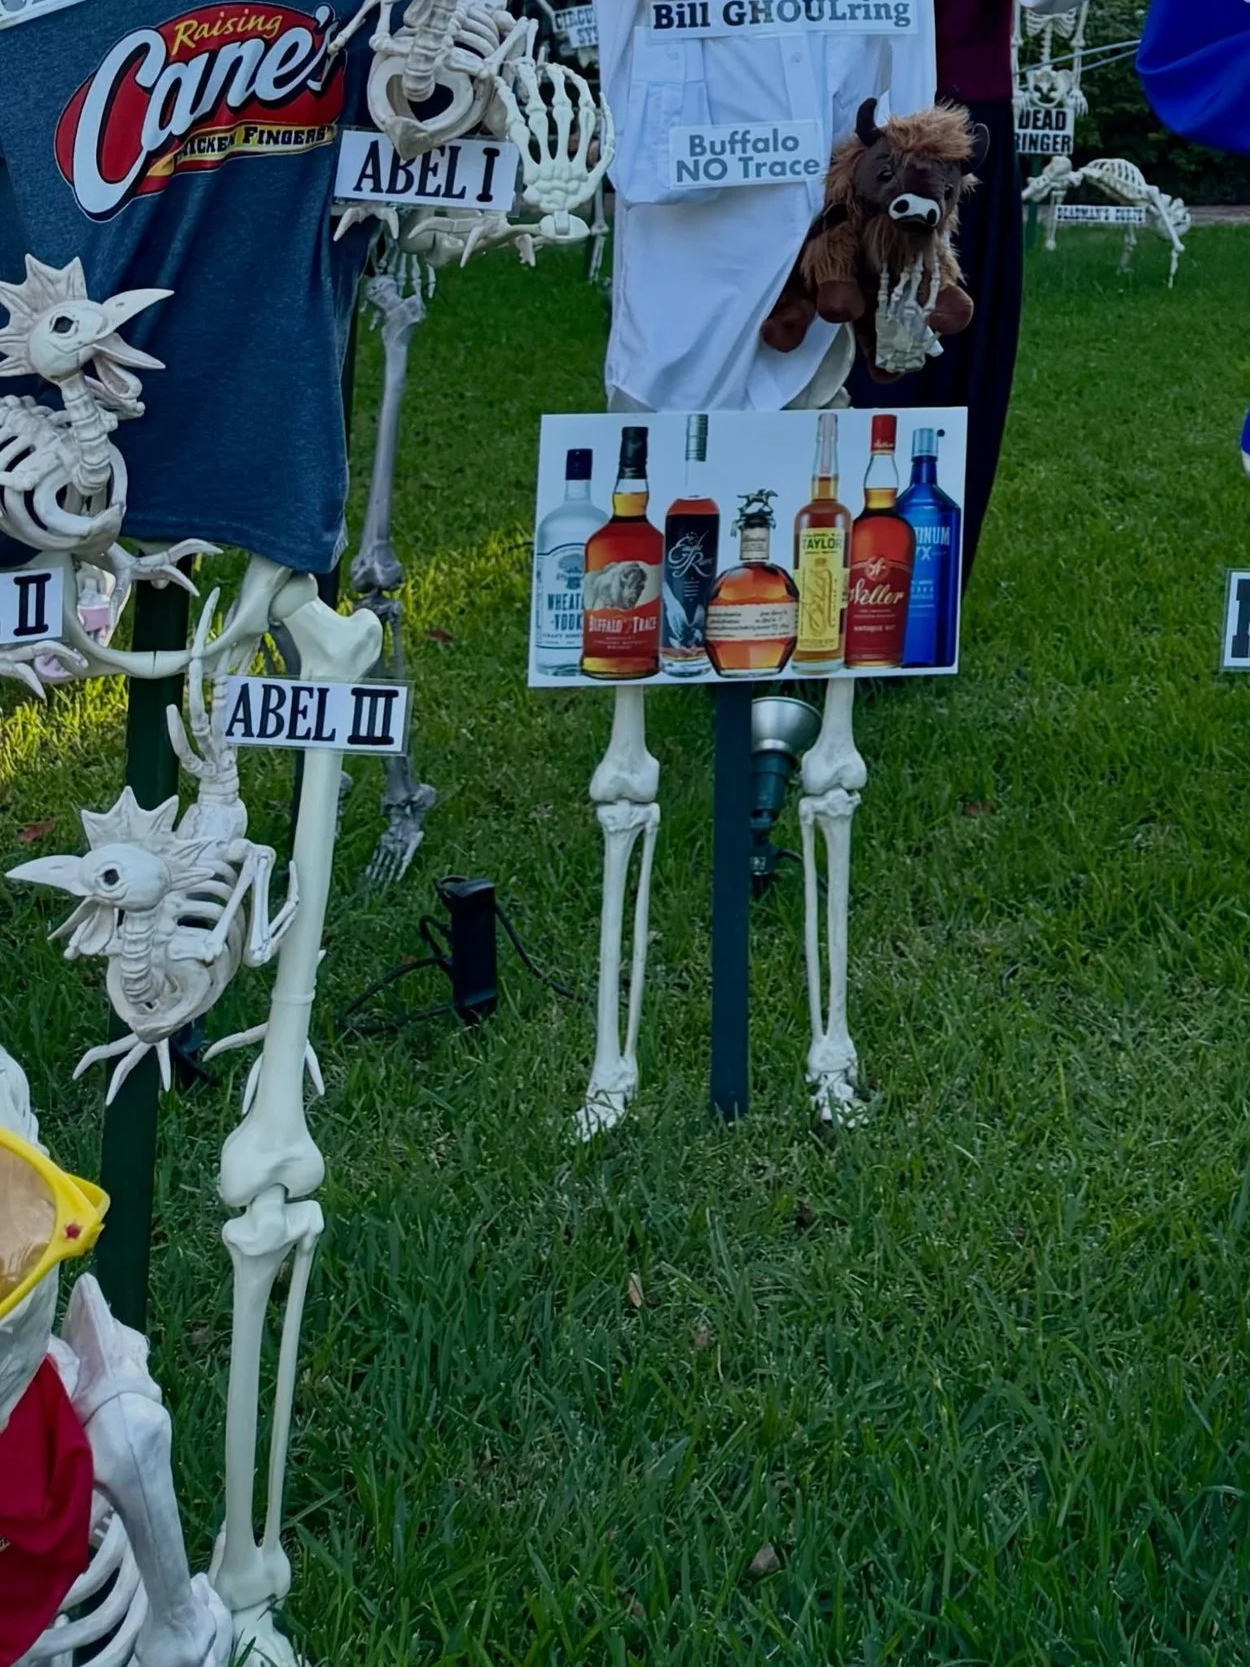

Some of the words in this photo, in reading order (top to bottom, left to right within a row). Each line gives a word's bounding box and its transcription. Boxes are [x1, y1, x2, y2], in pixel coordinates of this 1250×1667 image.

[653, 2, 711, 30] Bill
[172, 8, 283, 55] Raising
[73, 5, 337, 214] Cane's
[1018, 109, 1066, 130] DEAD
[243, 127, 326, 145] FINGERS
[689, 128, 799, 157] Buffalo
[353, 140, 467, 199] ABEL
[476, 147, 500, 202] I
[676, 158, 728, 182] NO
[738, 157, 820, 179] Trace
[225, 682, 337, 741] ABEL
[347, 687, 399, 745] III
